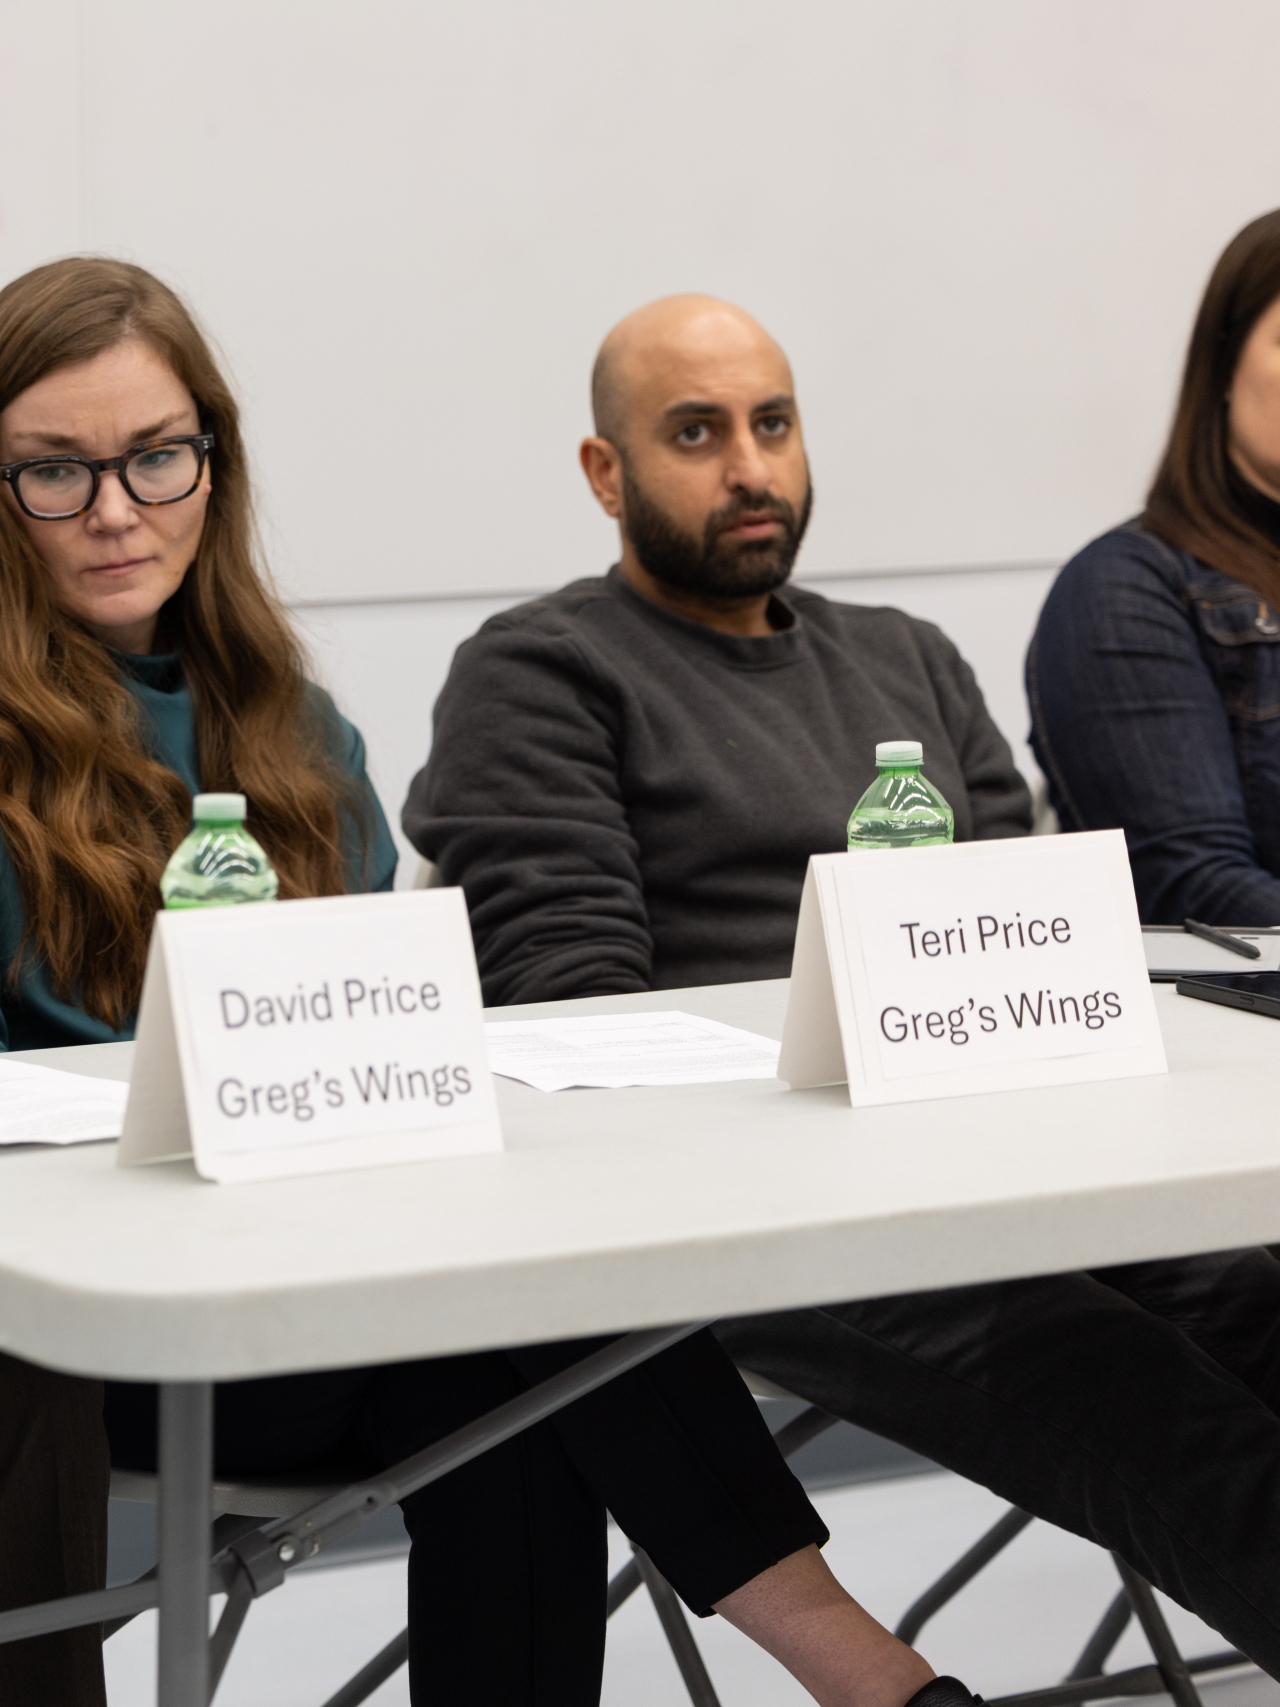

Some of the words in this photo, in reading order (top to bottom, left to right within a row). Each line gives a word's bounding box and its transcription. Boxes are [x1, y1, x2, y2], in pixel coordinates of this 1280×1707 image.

[898, 917, 967, 959] Teri
[976, 911, 1072, 952] Price
[219, 982, 333, 1030] David
[343, 976, 441, 1018] Price
[879, 997, 998, 1046] Greg’s
[1003, 989, 1123, 1031] Wings
[217, 1069, 345, 1122] Greg’s
[351, 1062, 473, 1107] Wings
